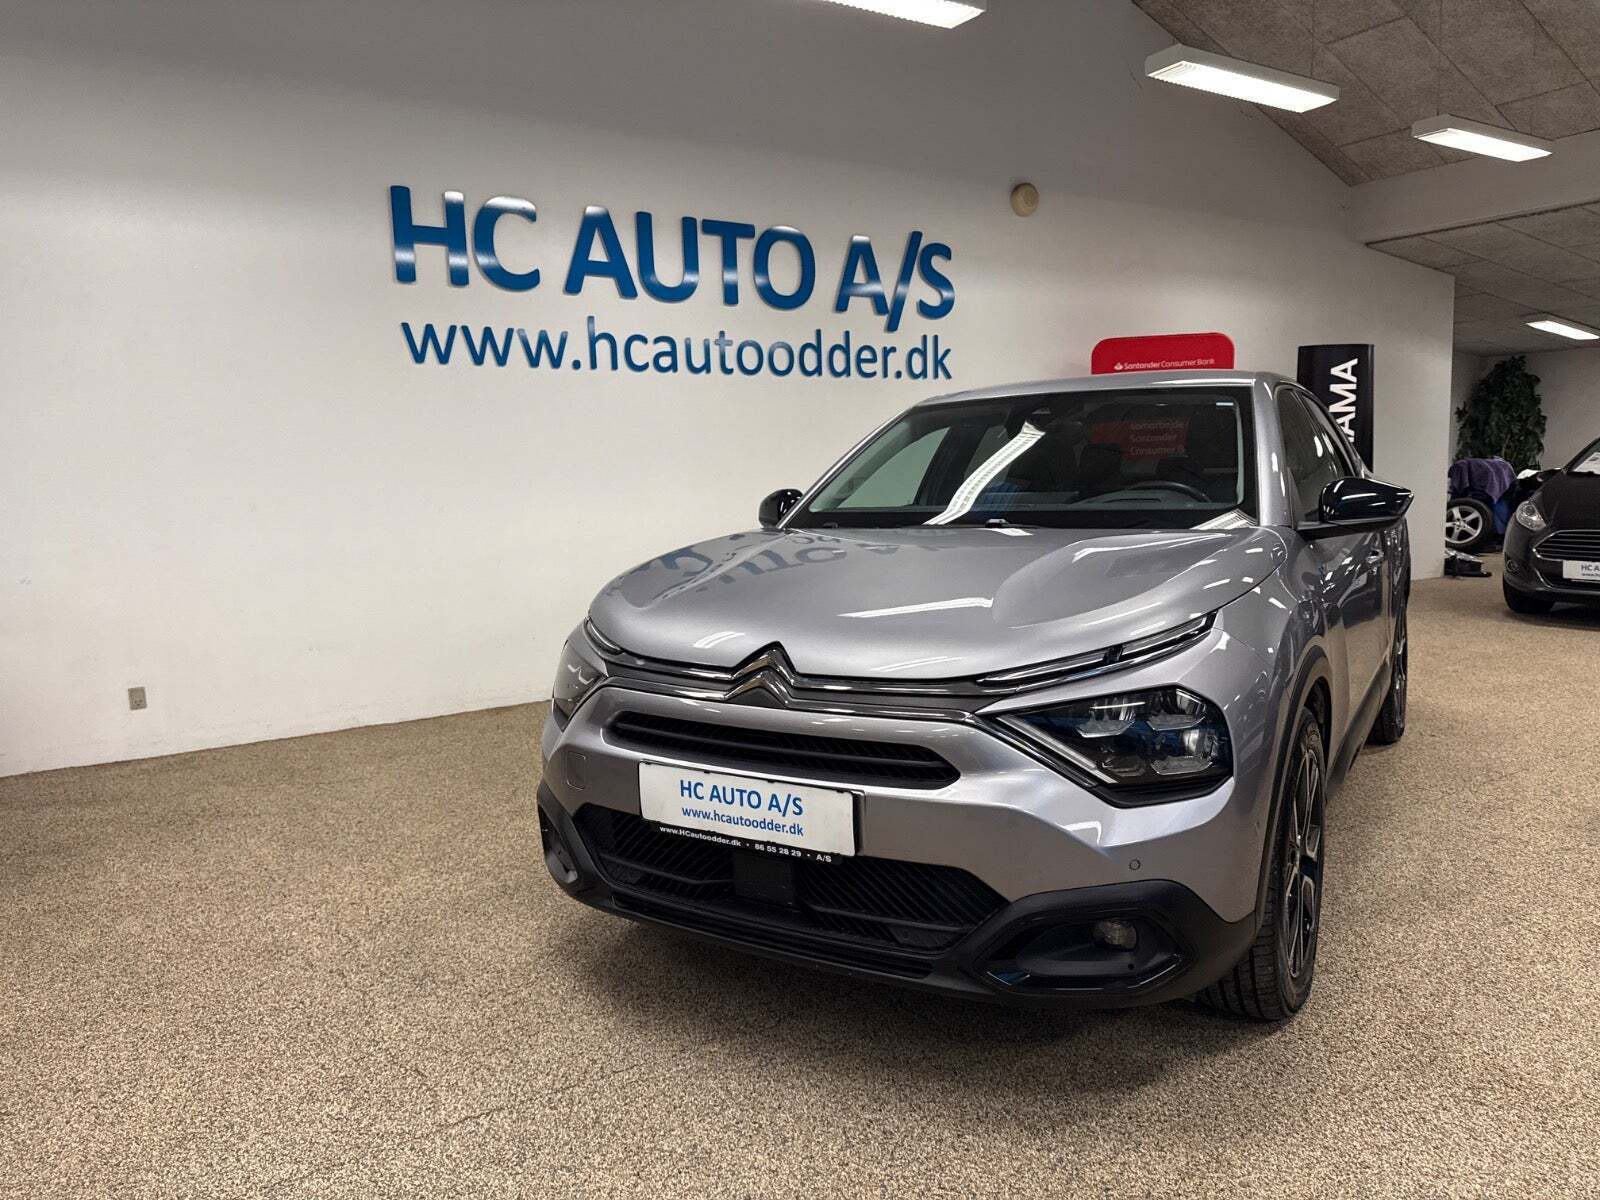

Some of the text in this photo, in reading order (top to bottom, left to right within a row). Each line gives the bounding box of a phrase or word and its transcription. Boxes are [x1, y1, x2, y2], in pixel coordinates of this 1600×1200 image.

[389, 184, 956, 333] HC AUTO A/S
[401, 315, 953, 381] www.hcautoodder.dk
[1124, 361, 1160, 370] Santander
[1161, 359, 1197, 368] Consumer
[680, 779, 804, 817] HC AUTO A/S
[682, 807, 804, 837] www.hcautoodder.dk
[659, 826, 742, 847] www.HCautoodder.dk
[816, 853, 832, 863] A/S
